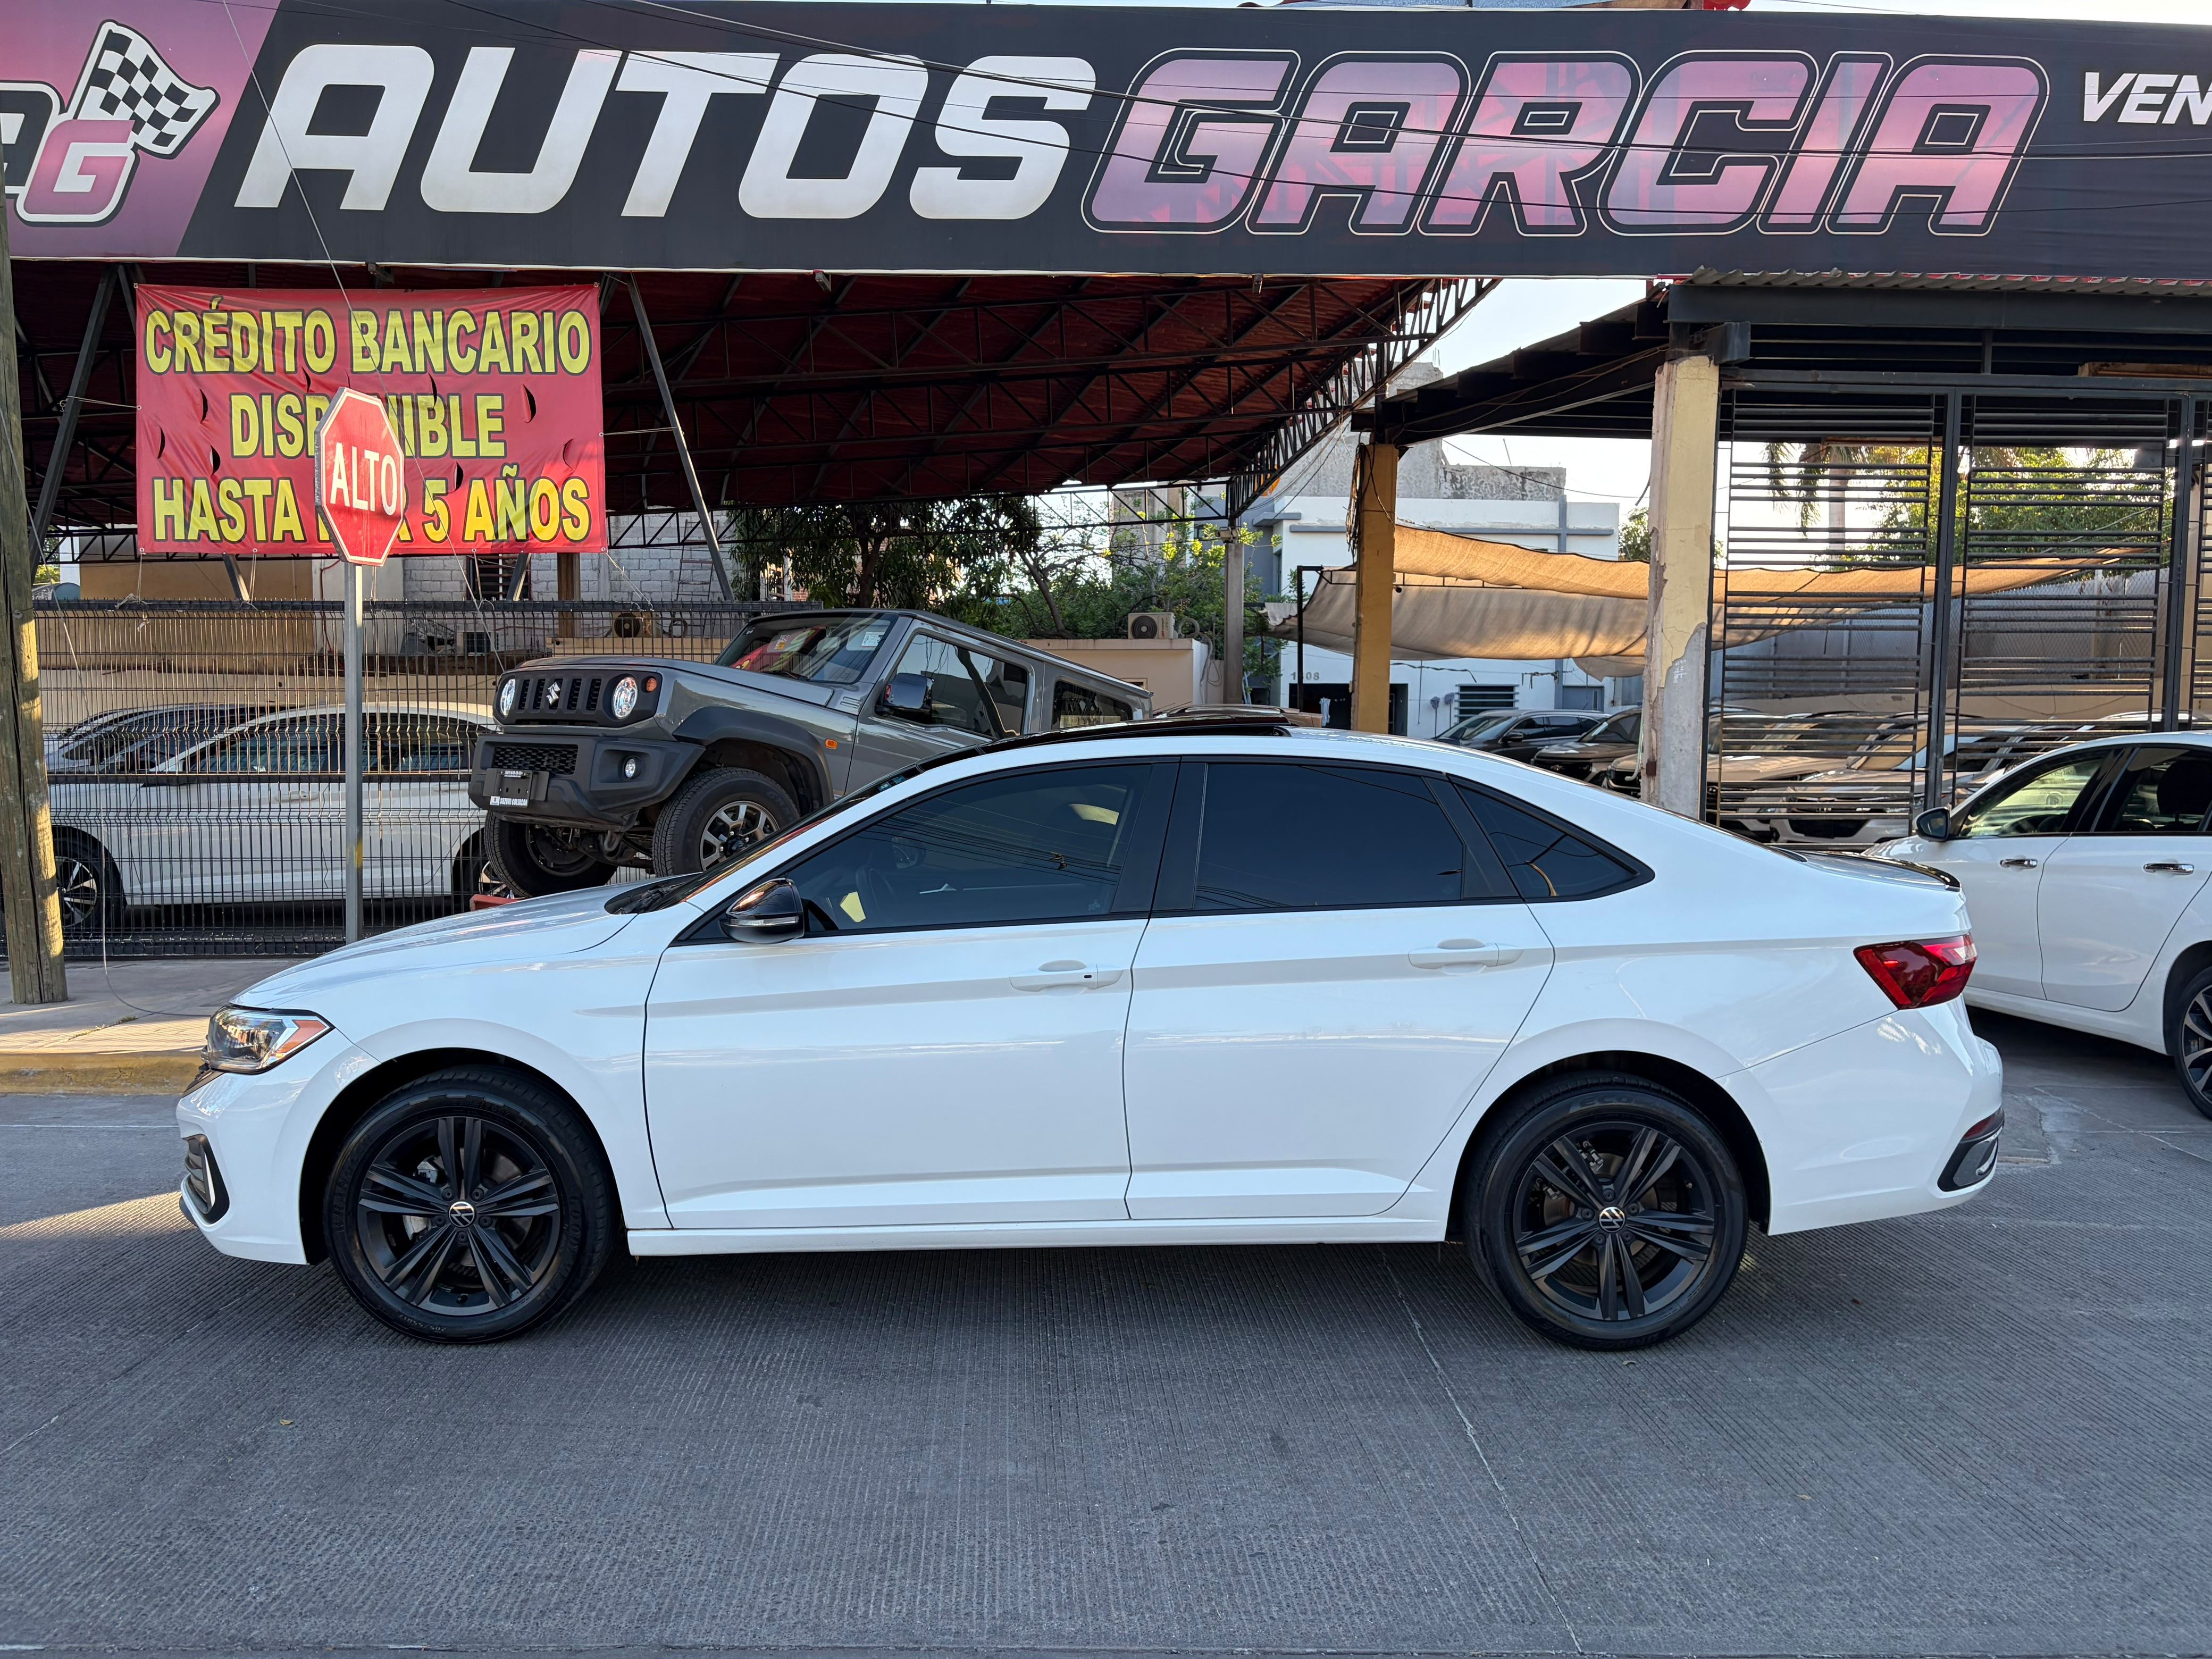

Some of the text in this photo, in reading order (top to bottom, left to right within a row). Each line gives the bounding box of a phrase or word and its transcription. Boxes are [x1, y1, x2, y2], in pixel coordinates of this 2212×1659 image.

[2083, 72, 2212, 125] VEN
[234, 44, 2050, 237] AUTOS GARCIA
[144, 296, 592, 376] CRÉDITO BANCARIO
[230, 392, 507, 459] DISPIBLE
[152, 477, 306, 542] HASTA
[422, 477, 450, 543] 5
[464, 463, 591, 543] AÑOS
[330, 442, 398, 515] ALTO
